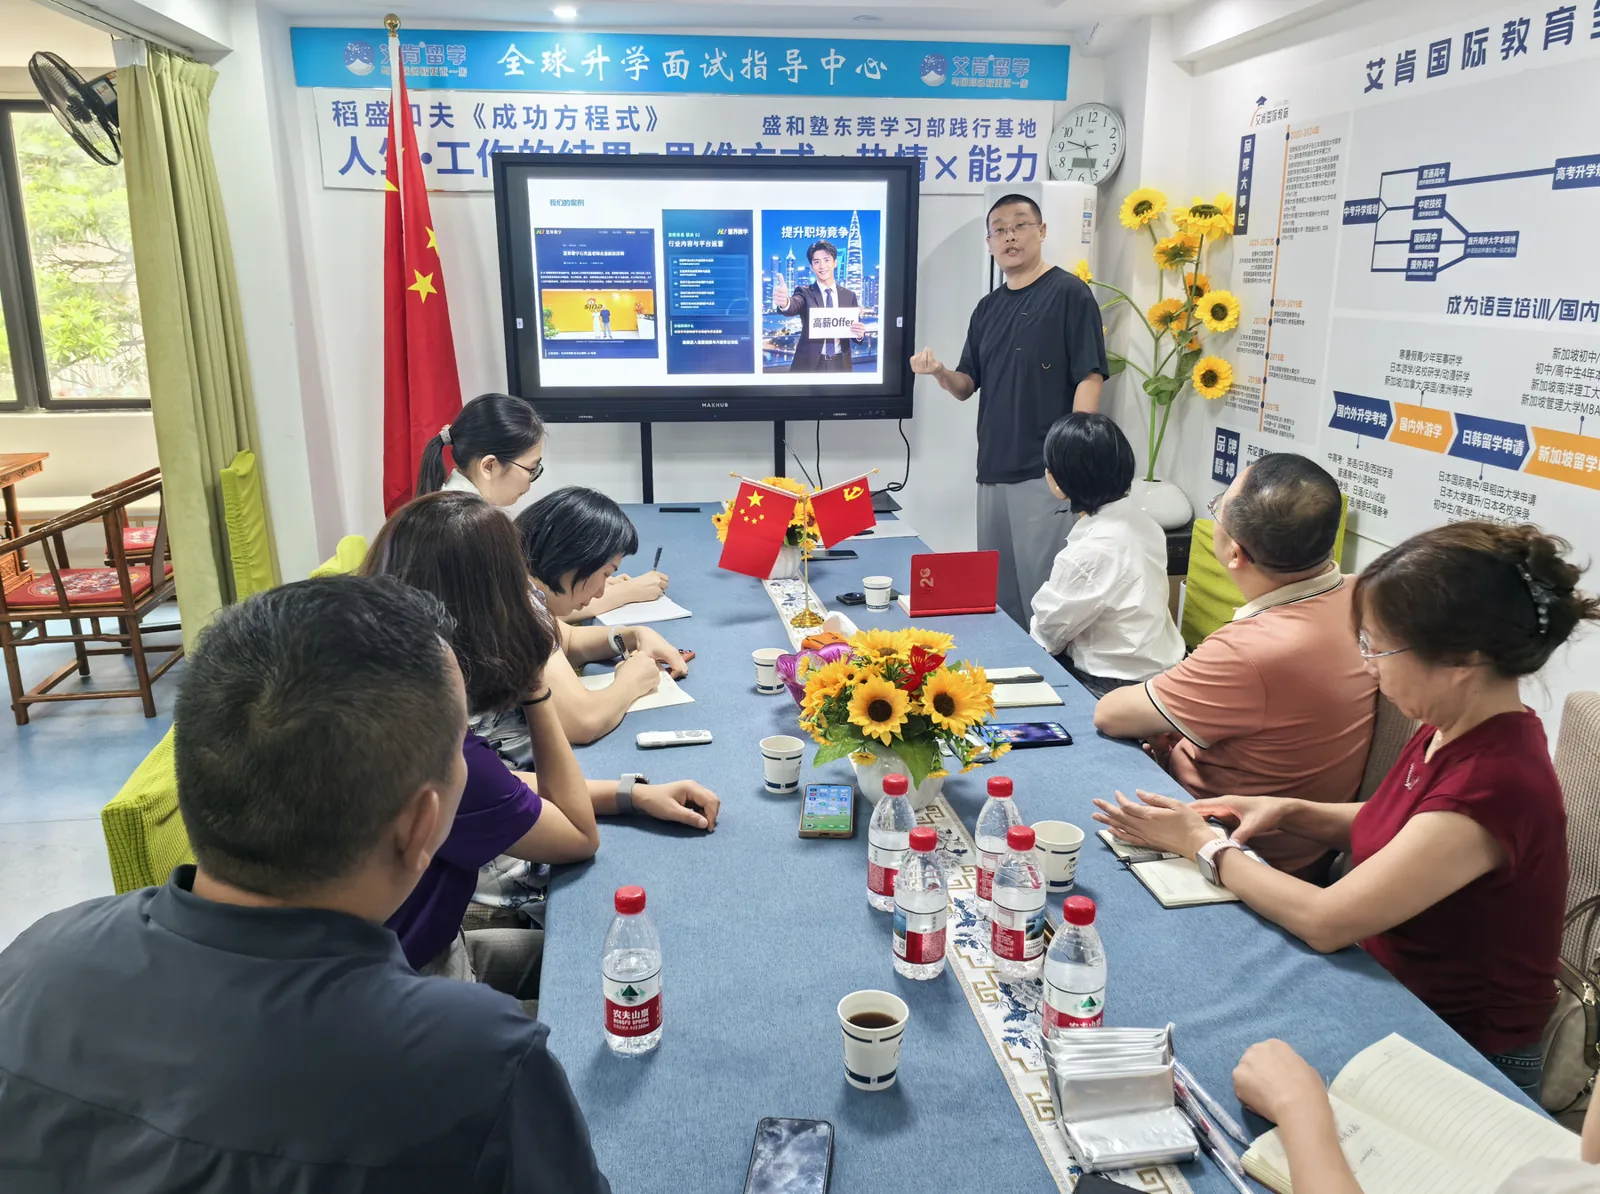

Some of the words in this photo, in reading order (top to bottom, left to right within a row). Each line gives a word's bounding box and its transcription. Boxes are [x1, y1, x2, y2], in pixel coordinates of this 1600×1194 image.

[496, 43, 889, 86] 全球升学面试指导中心
[1075, 116, 1083, 127] 11
[1088, 112, 1098, 122] 12
[1103, 116, 1107, 127] 1
[762, 115, 1037, 139] 盛和塾东莞学习部践行基地
[1064, 127, 1073, 138] 10
[1109, 127, 1117, 139] 2
[1058, 142, 1065, 153] 9
[1109, 143, 1117, 155] 3
[1059, 157, 1066, 168] 8
[1102, 159, 1109, 169] 4
[1067, 169, 1074, 179] 7
[1092, 170, 1098, 181] 5
[549, 199, 585, 207] 我们的案例
[1343, 203, 1378, 217] 中考升学规划
[668, 240, 724, 248] 行业内容与平台运营
[1446, 295, 1600, 322] 成为语言培训/国内
[812, 317, 854, 329] 高薪Offer
[1552, 347, 1600, 364] 新加坡初中/
[1531, 378, 1600, 400] 新加坡南洋理工大
[1336, 404, 1387, 428] 国内外升学考培
[1399, 417, 1442, 439] 国内外游学
[1462, 429, 1525, 457] 日韩留学申请
[1537, 445, 1600, 473] 新加坡留学
[1438, 470, 1537, 506] 日本国际高中/早稻田大学申请
[1440, 486, 1530, 520] 日本大学直升/日本名校保录
[613, 1008, 649, 1020] 农夫山泉
